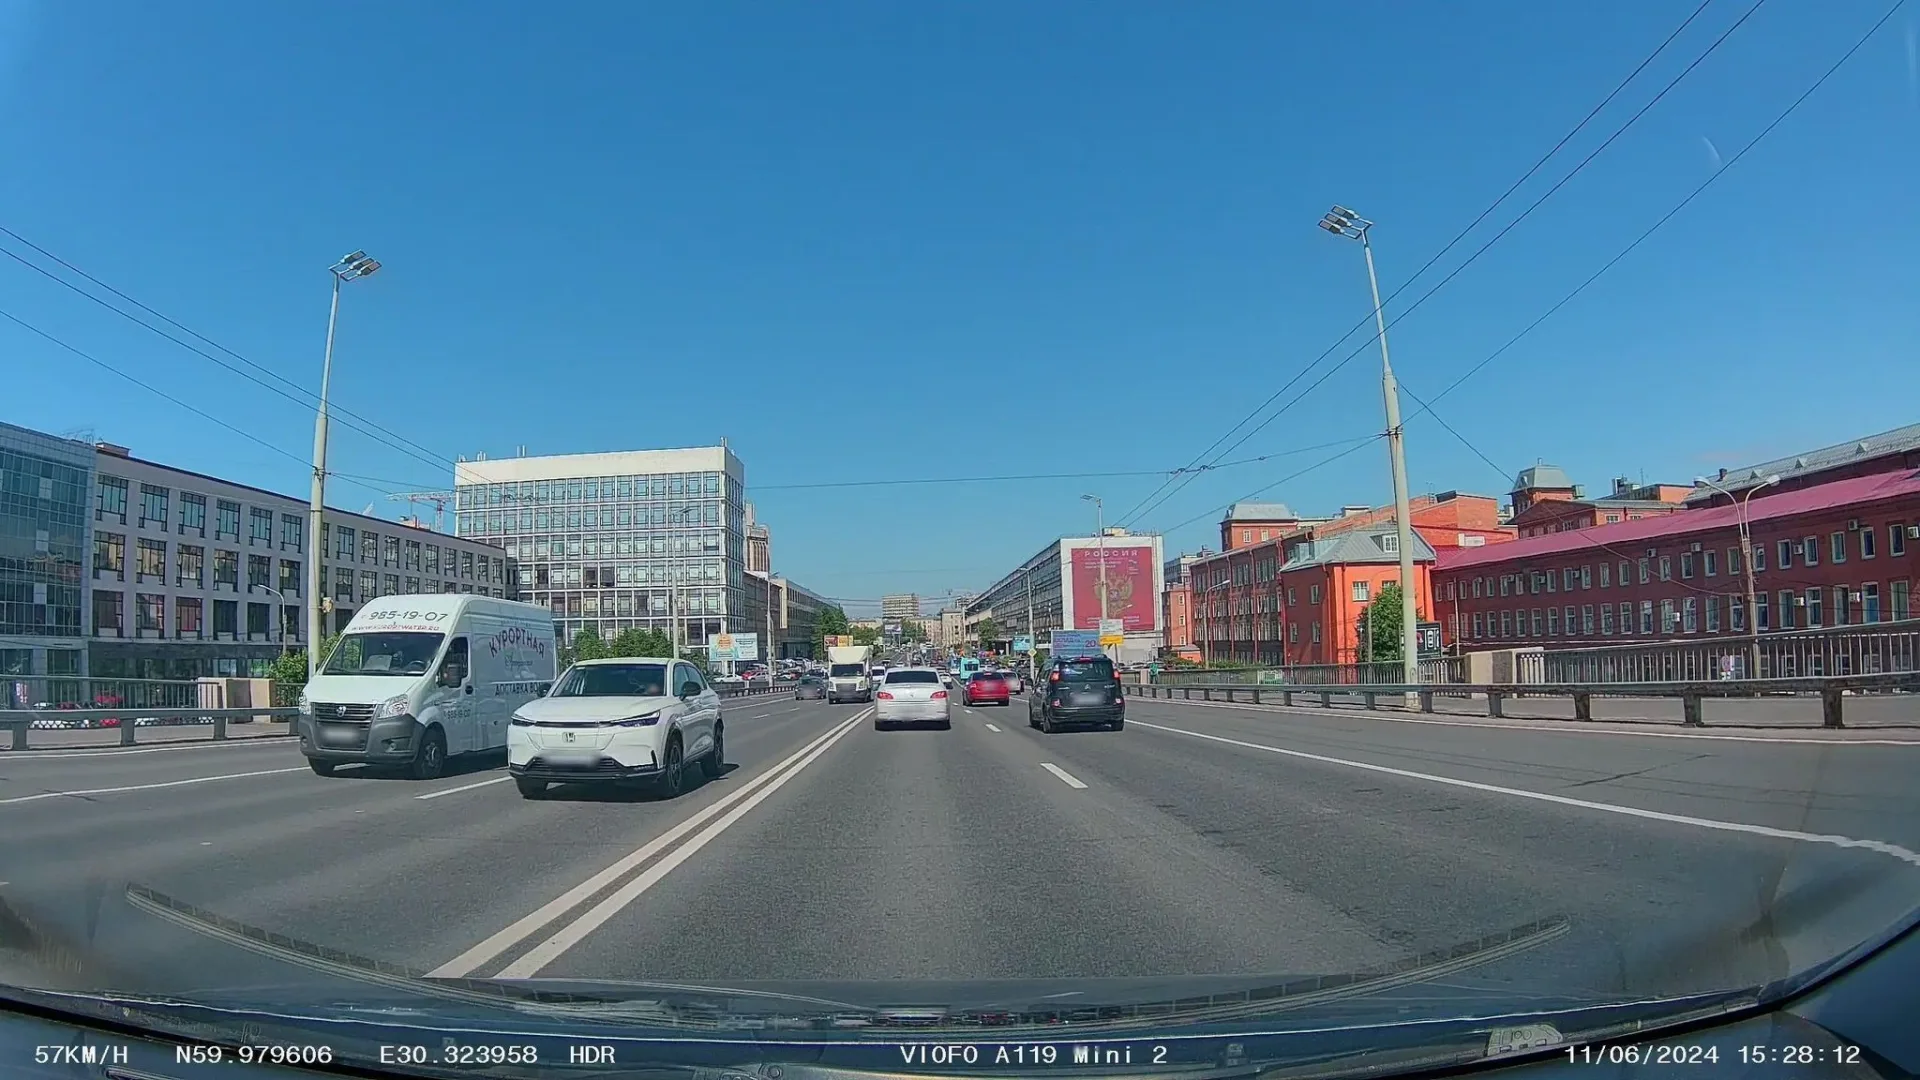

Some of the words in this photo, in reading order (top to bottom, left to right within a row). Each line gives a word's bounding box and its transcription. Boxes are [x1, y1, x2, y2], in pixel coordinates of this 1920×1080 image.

[368, 610, 449, 622] 985-19-07
[489, 628, 545, 658] КУРОРТНАЯ
[494, 682, 529, 697] ДОСТАВКА
